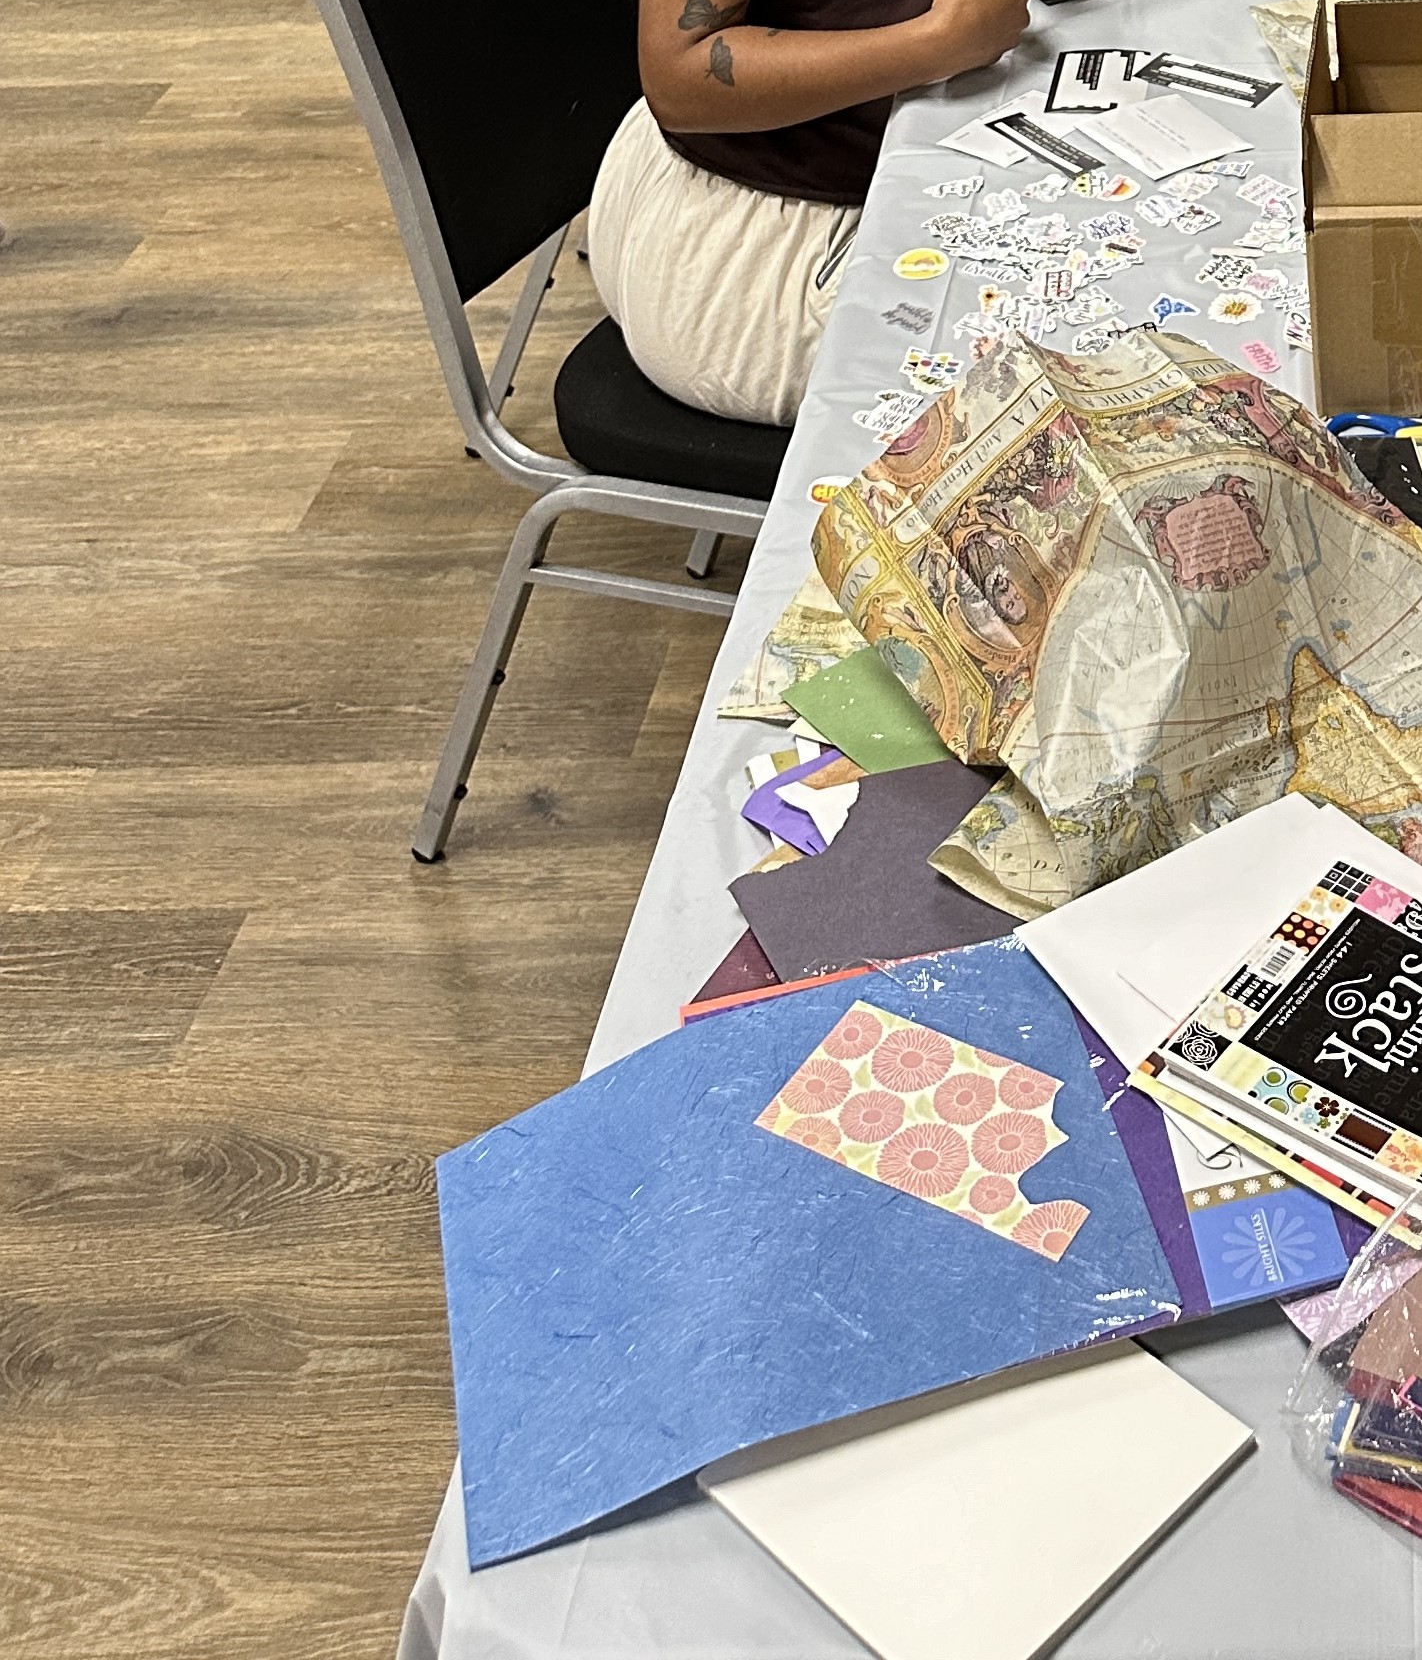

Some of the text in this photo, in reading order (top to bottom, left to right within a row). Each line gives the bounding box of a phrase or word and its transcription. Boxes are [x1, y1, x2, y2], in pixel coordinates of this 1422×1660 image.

[1316, 958, 1338, 980] SHEETS
[1295, 980, 1318, 1005] PRINTED
[1277, 1005, 1297, 1026] PAPER
[1251, 1213, 1278, 1282] BRIGHT SILKS
